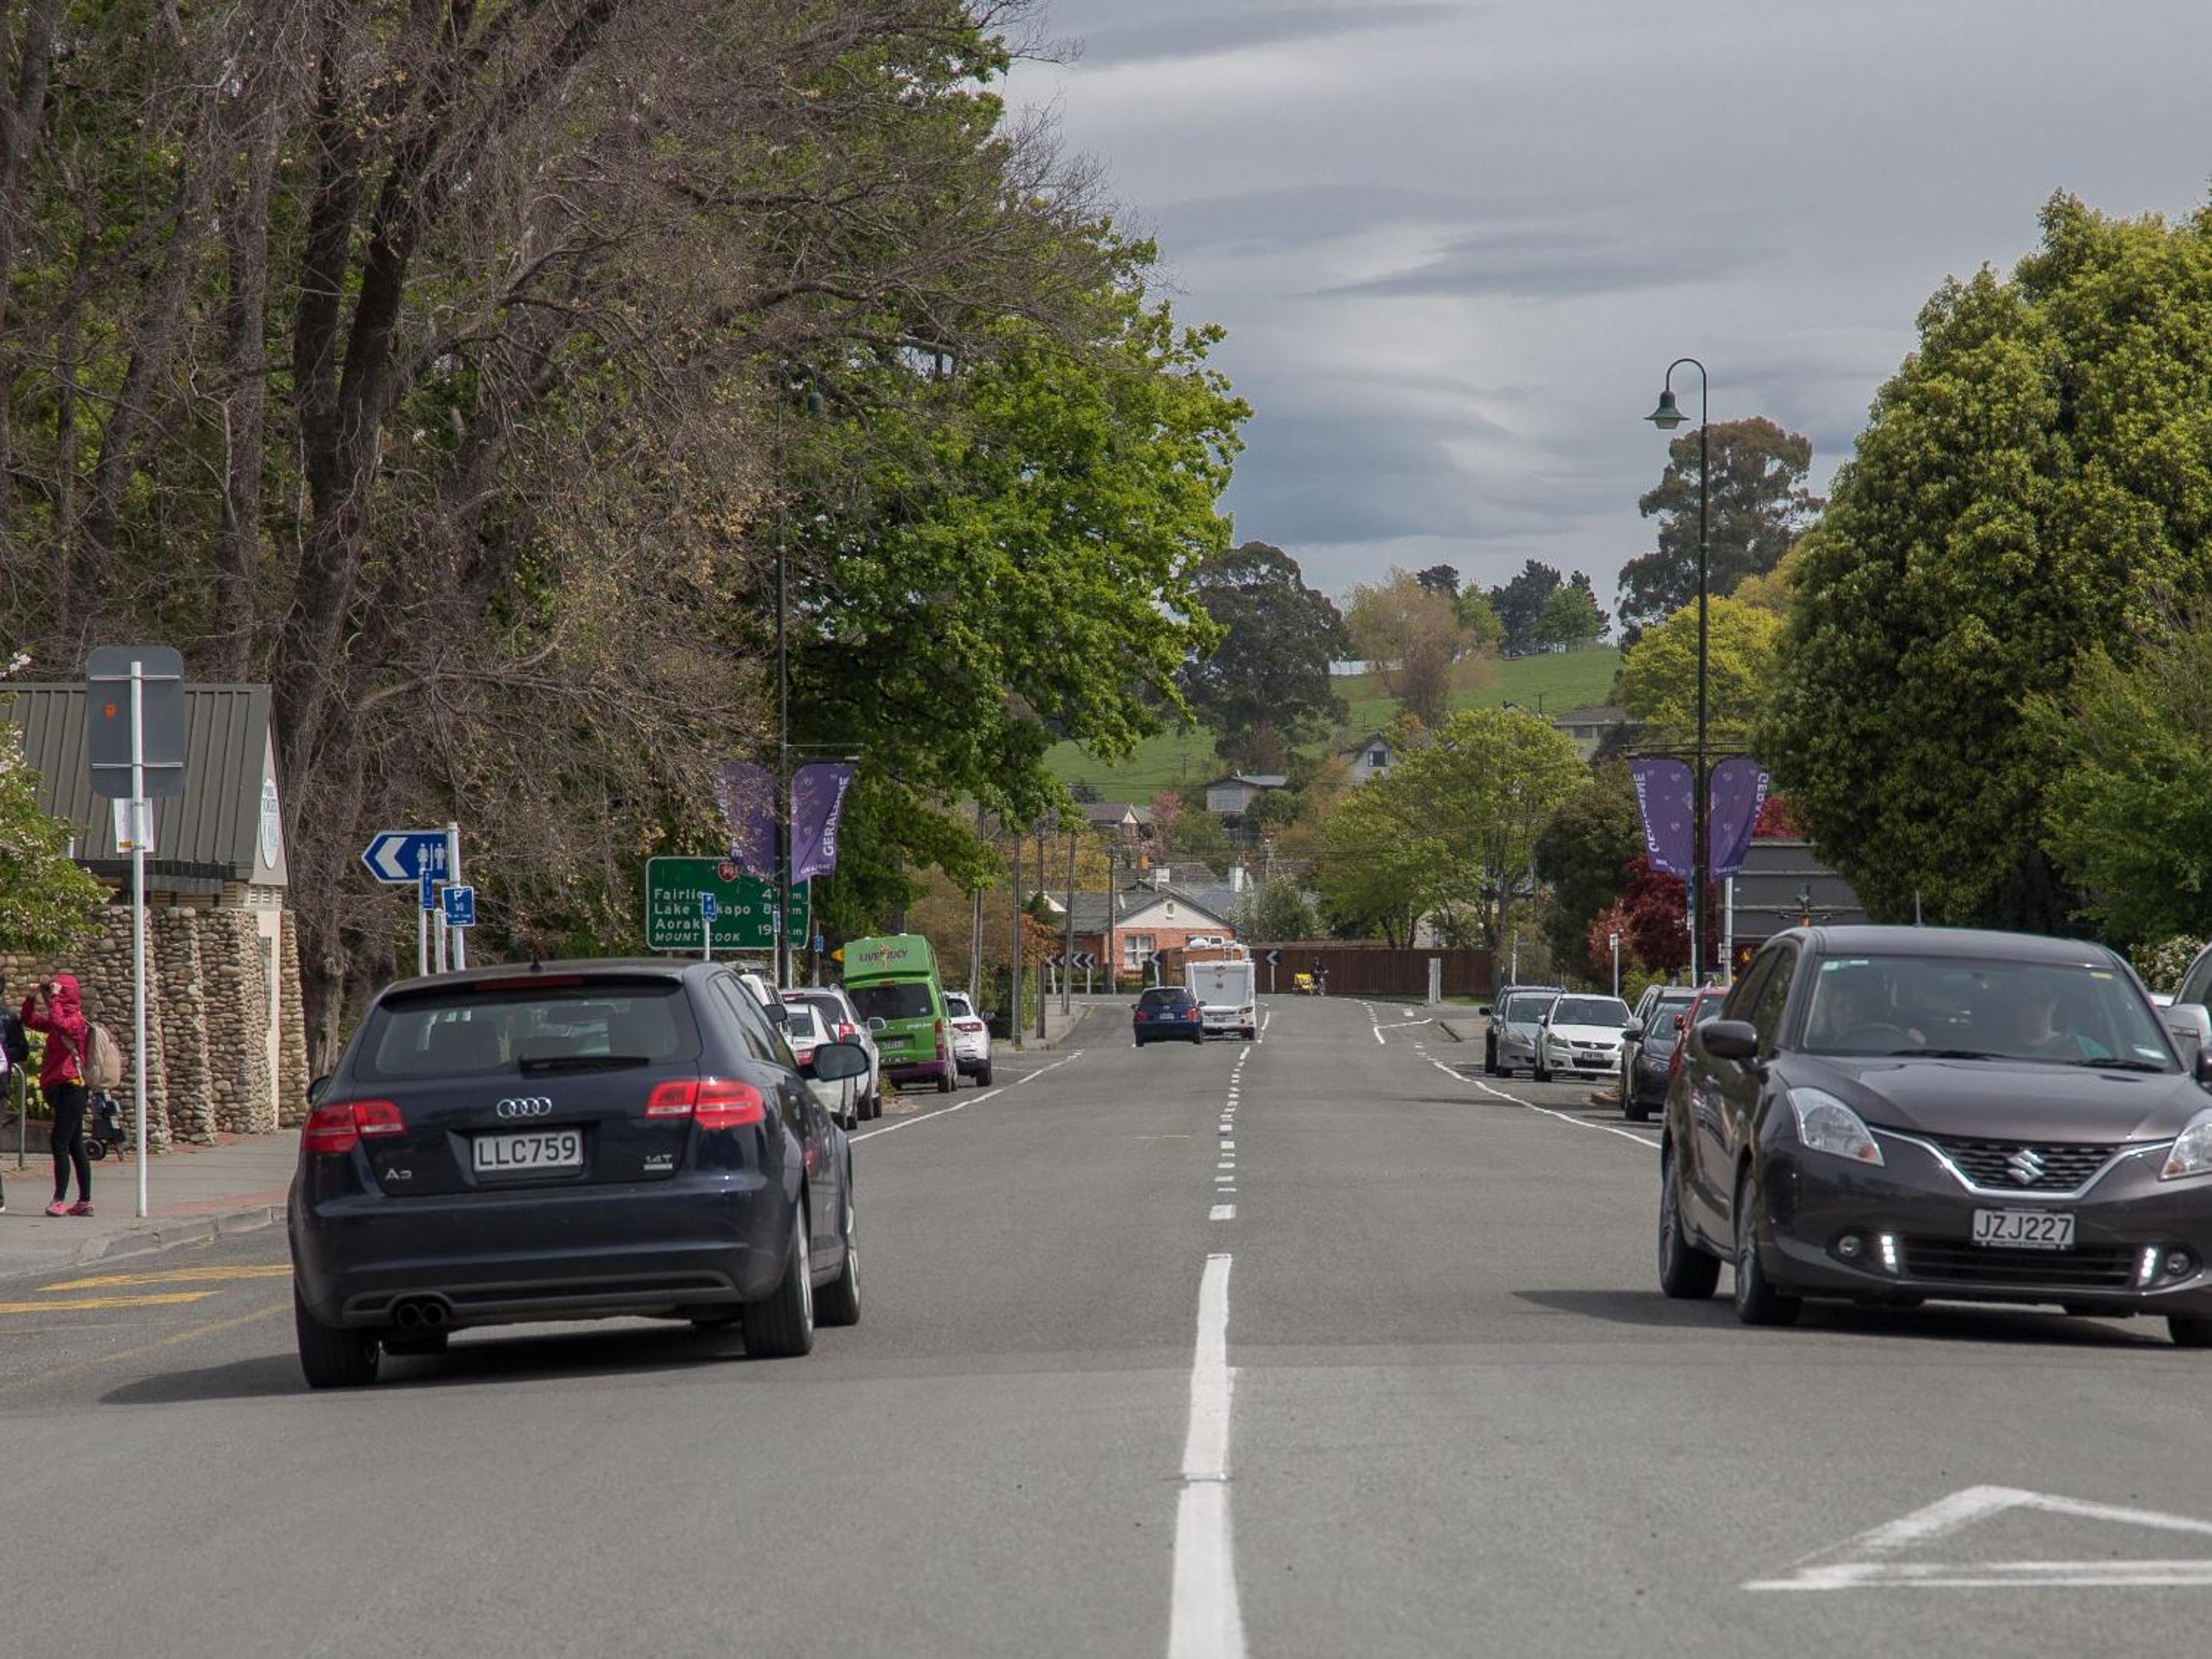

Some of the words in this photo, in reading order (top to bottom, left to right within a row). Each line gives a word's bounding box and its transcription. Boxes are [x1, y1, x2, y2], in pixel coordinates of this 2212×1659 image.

[654, 902, 690, 915] Lake
[697, 902, 751, 917] kapo
[654, 932, 700, 942] MOUNT
[478, 1135, 577, 1167] LLC759
[385, 1168, 412, 1180] A3
[1976, 1214, 2072, 1242] JZJ227
